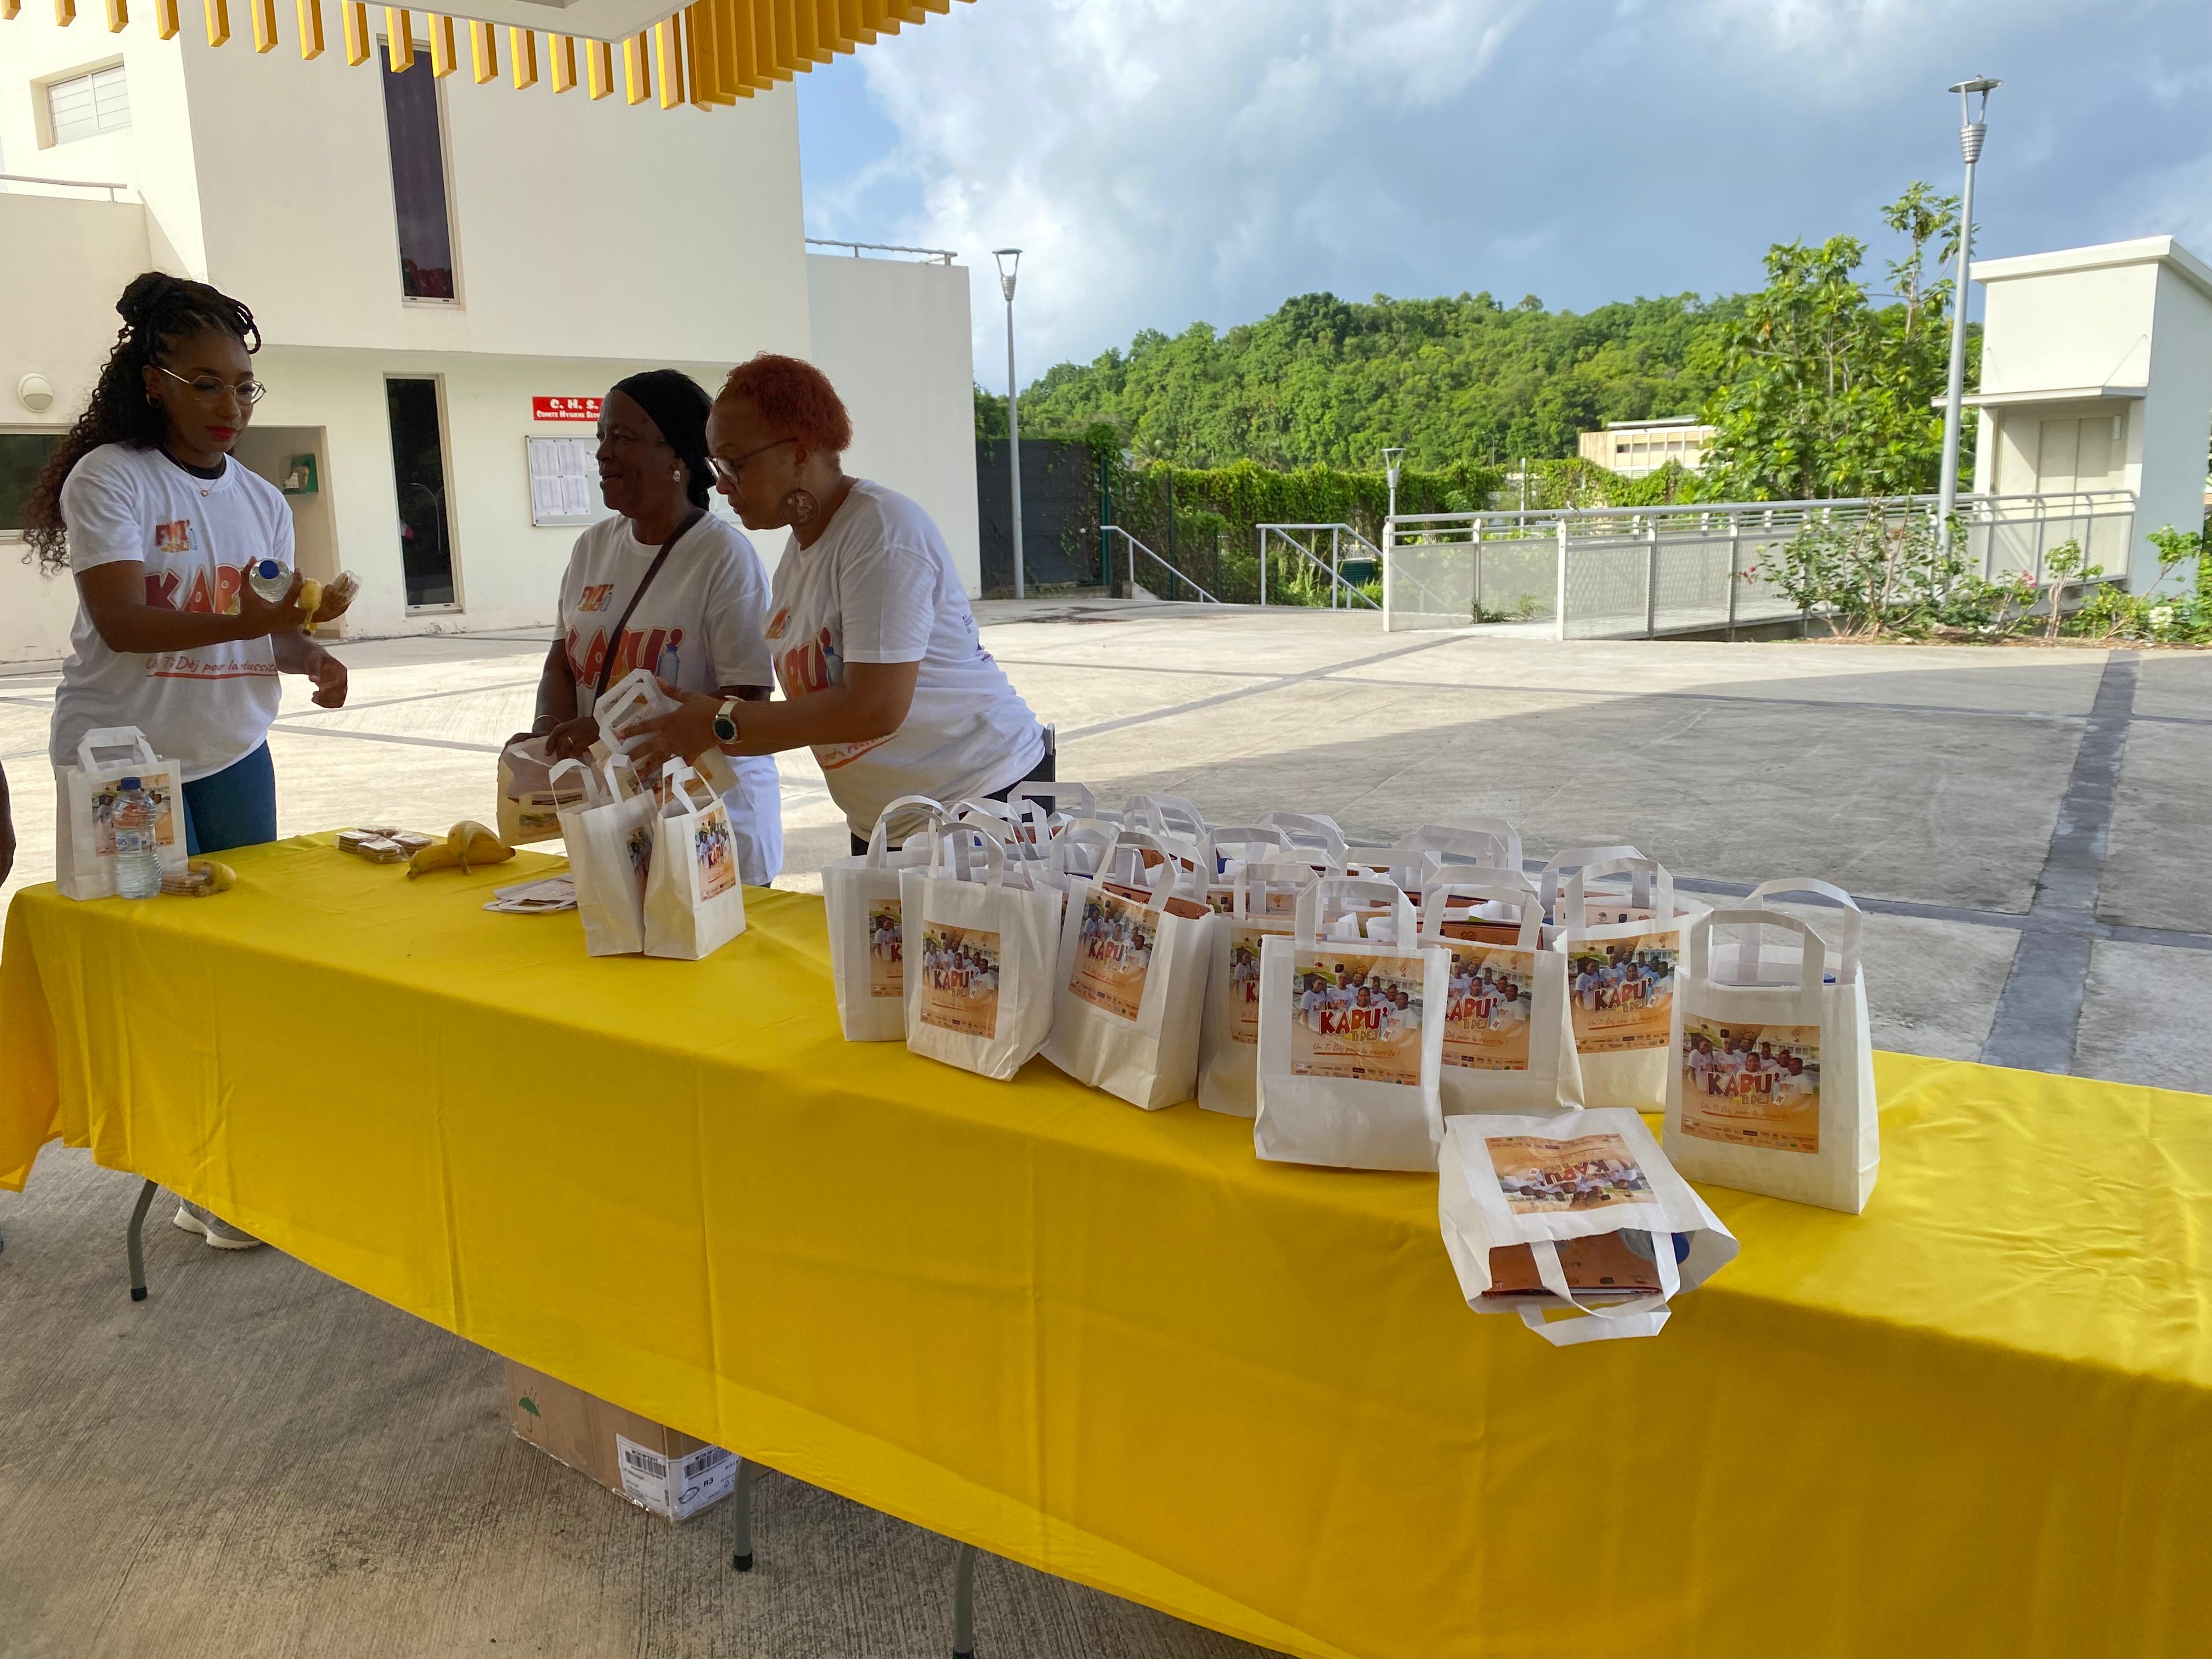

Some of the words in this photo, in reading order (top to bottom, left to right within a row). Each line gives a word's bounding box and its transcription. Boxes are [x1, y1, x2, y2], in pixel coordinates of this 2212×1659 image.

[550, 398, 564, 409] C.
[567, 399, 583, 409] H.
[586, 399, 599, 410] S.
[703, 1477, 714, 1487] R3
